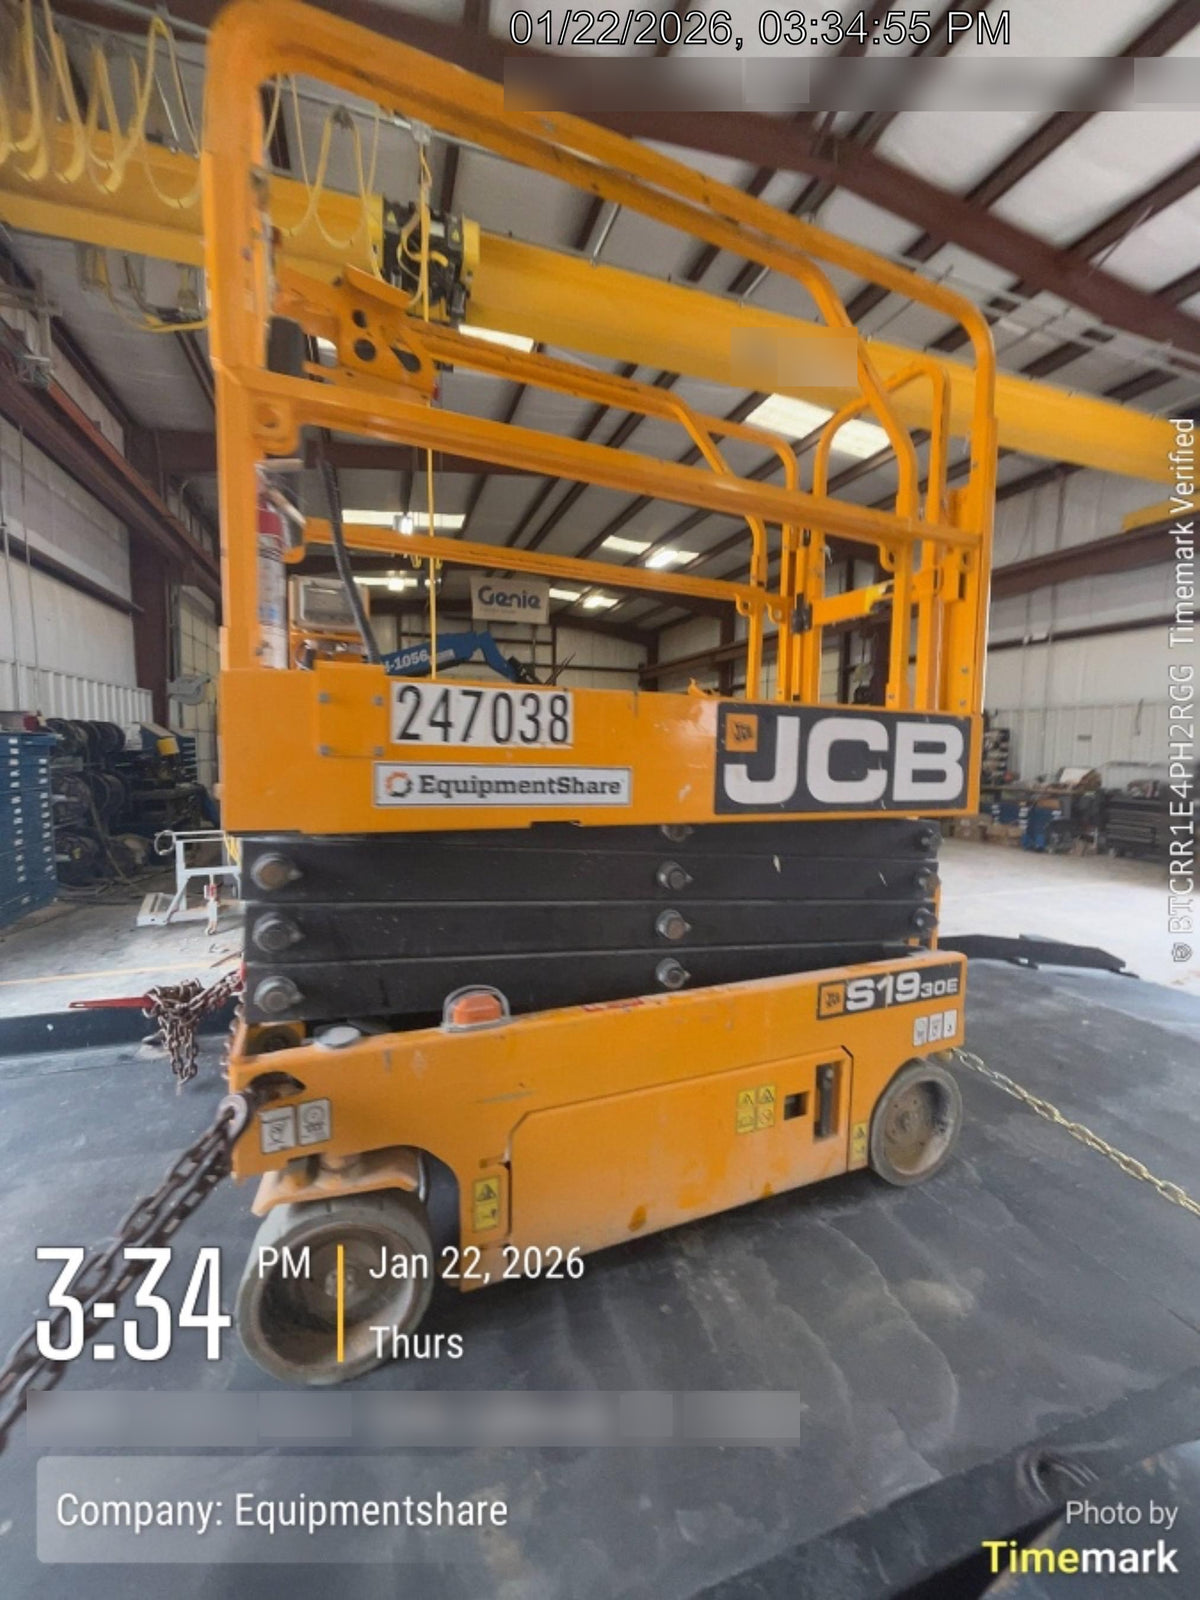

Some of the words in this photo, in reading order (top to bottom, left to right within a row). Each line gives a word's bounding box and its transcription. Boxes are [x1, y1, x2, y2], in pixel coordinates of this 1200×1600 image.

[477, 585, 542, 610] Genie
[396, 685, 569, 744] 247038
[723, 715, 965, 805] JCB
[418, 774, 621, 799] EquipmentShare
